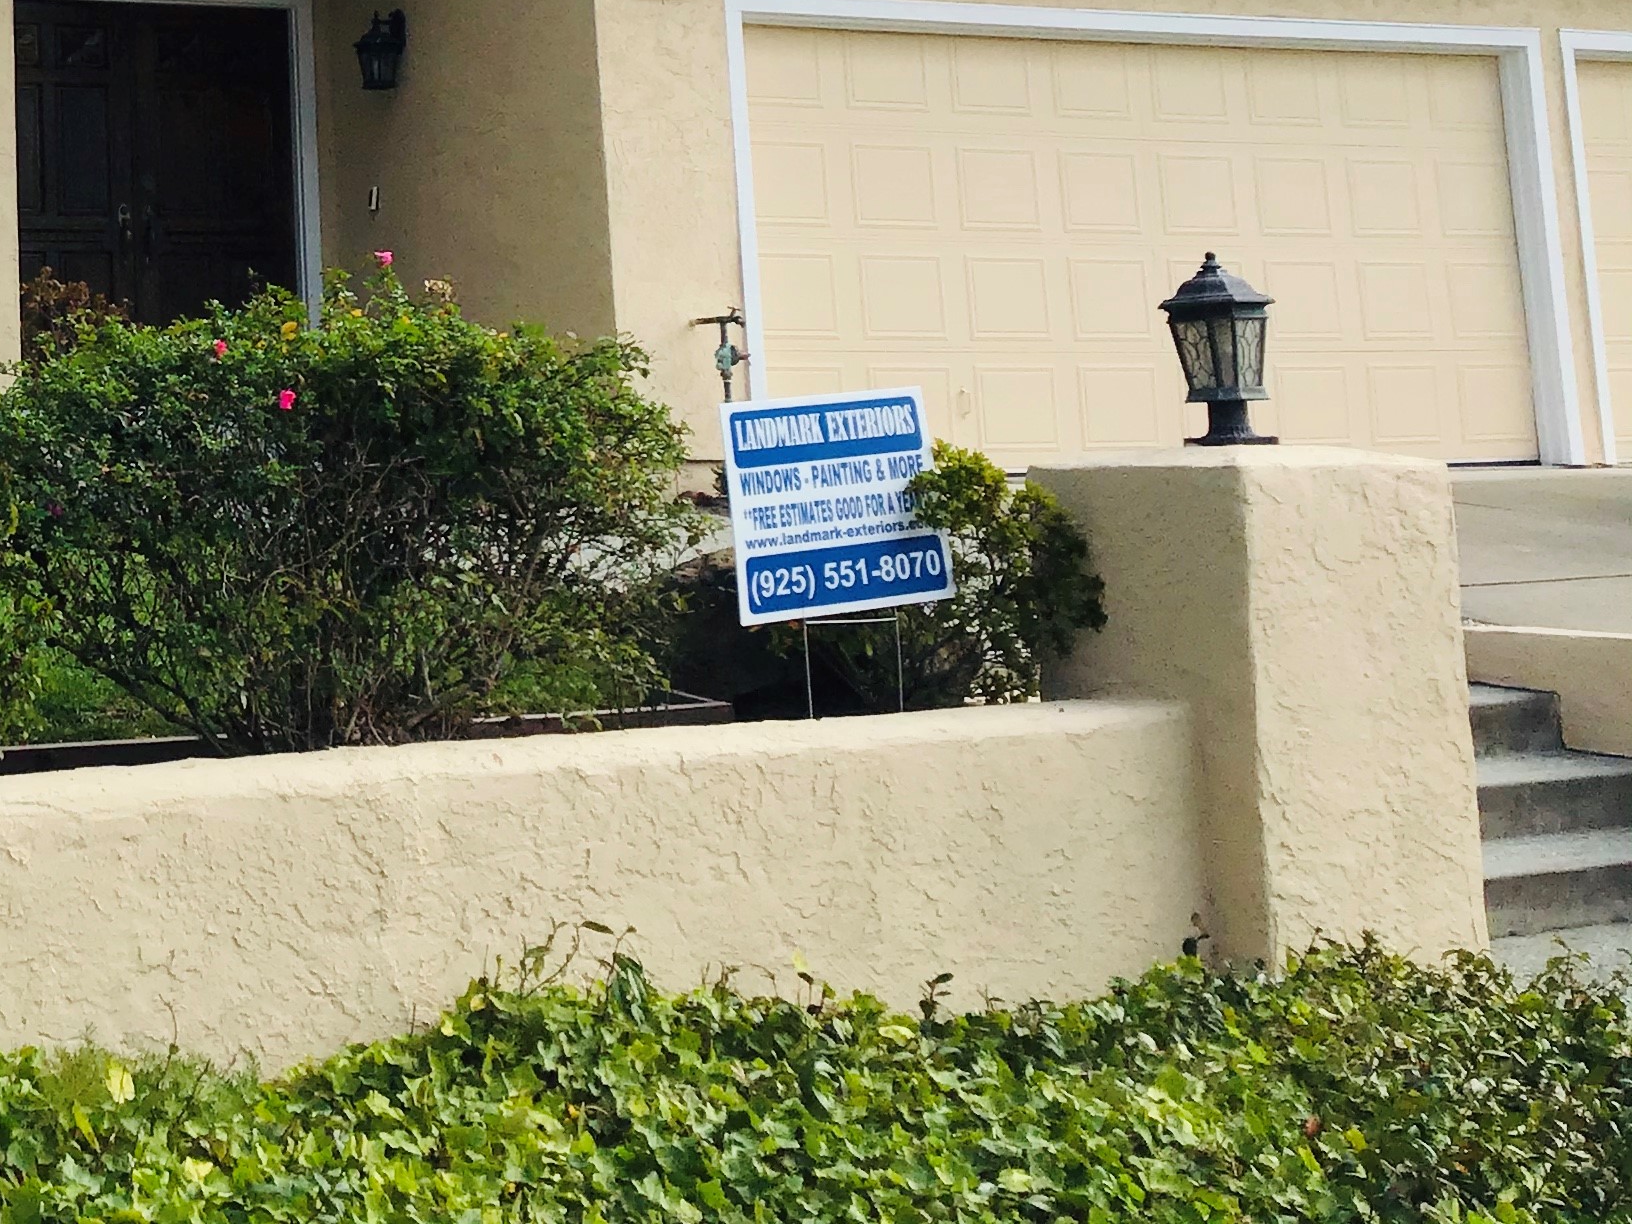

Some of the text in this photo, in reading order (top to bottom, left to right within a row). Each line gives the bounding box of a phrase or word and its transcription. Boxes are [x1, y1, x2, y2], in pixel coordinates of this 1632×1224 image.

[734, 403, 916, 451] LANDMARK EXTERIORS
[739, 467, 802, 496] WINDOWS
[811, 459, 872, 489] PAINTING
[876, 458, 886, 482] &
[779, 499, 834, 528] ESTIMATES
[835, 495, 864, 520] GOOD
[864, 493, 887, 517] FOR
[887, 492, 896, 515] A
[751, 549, 941, 606] (925) 551-8070
